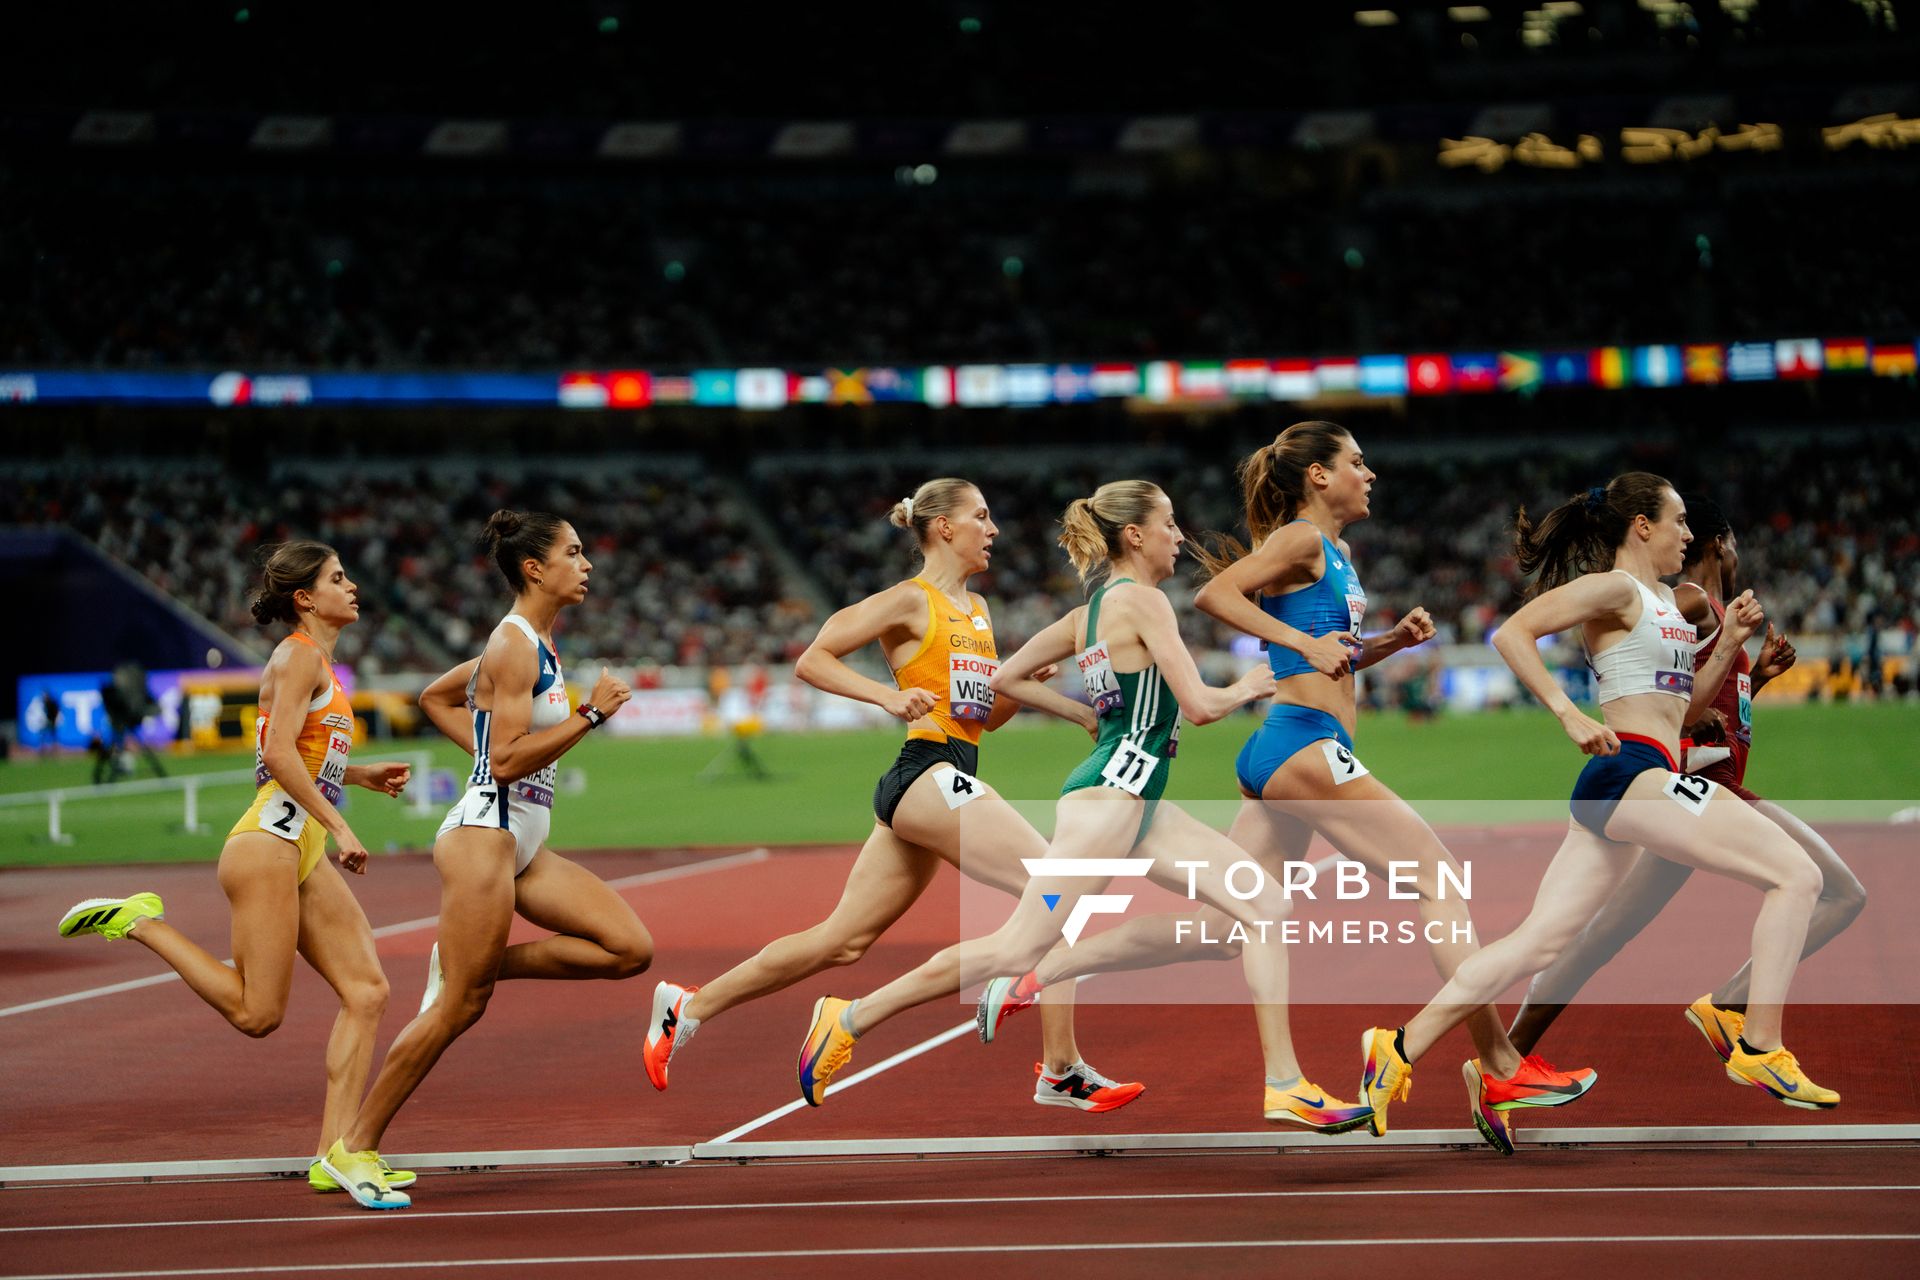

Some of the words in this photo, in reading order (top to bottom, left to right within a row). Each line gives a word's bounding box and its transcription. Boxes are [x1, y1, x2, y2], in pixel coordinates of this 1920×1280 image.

[950, 634, 995, 654] GERMAN
[1661, 627, 1696, 644] HOND
[952, 659, 998, 677] HOND
[1739, 680, 1751, 694] H
[1116, 750, 1150, 785] 11
[1336, 746, 1355, 774] 9
[952, 775, 974, 795] 4
[1673, 775, 1709, 805] 13
[272, 800, 297, 833] 2
[476, 791, 498, 820] 7
